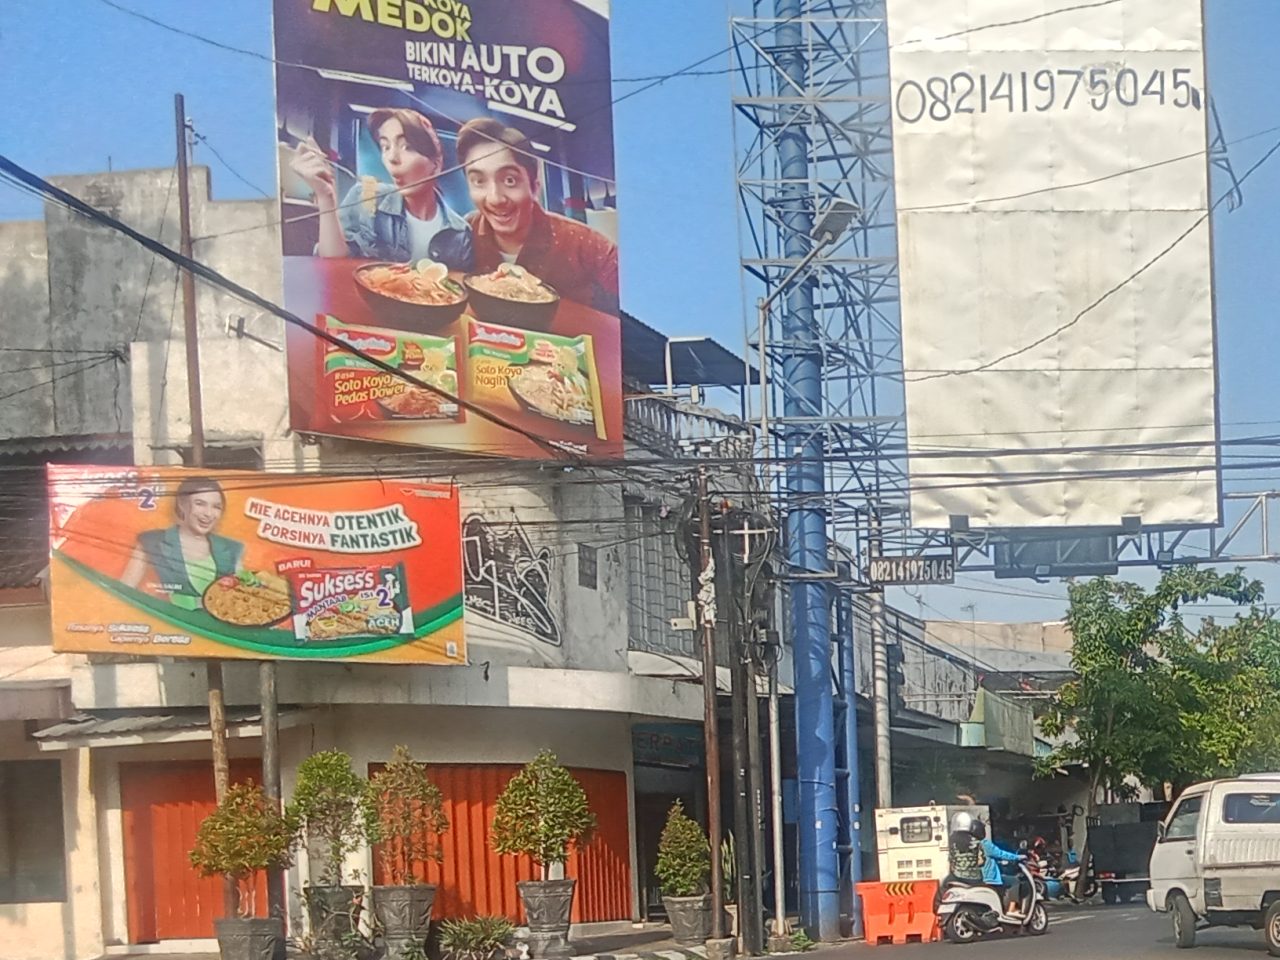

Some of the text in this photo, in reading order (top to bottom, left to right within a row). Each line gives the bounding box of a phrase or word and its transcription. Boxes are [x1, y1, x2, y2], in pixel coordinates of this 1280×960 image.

[405, 41, 565, 84] BIKIN AUTO
[406, 62, 565, 119] TERKOYA-KOYA
[896, 68, 1193, 124] 082141975045
[250, 501, 405, 531] MIE ACEHNYA OTENTIK
[262, 522, 417, 549] PORSINYA FANTASTIK
[869, 558, 953, 584] 082141975045
